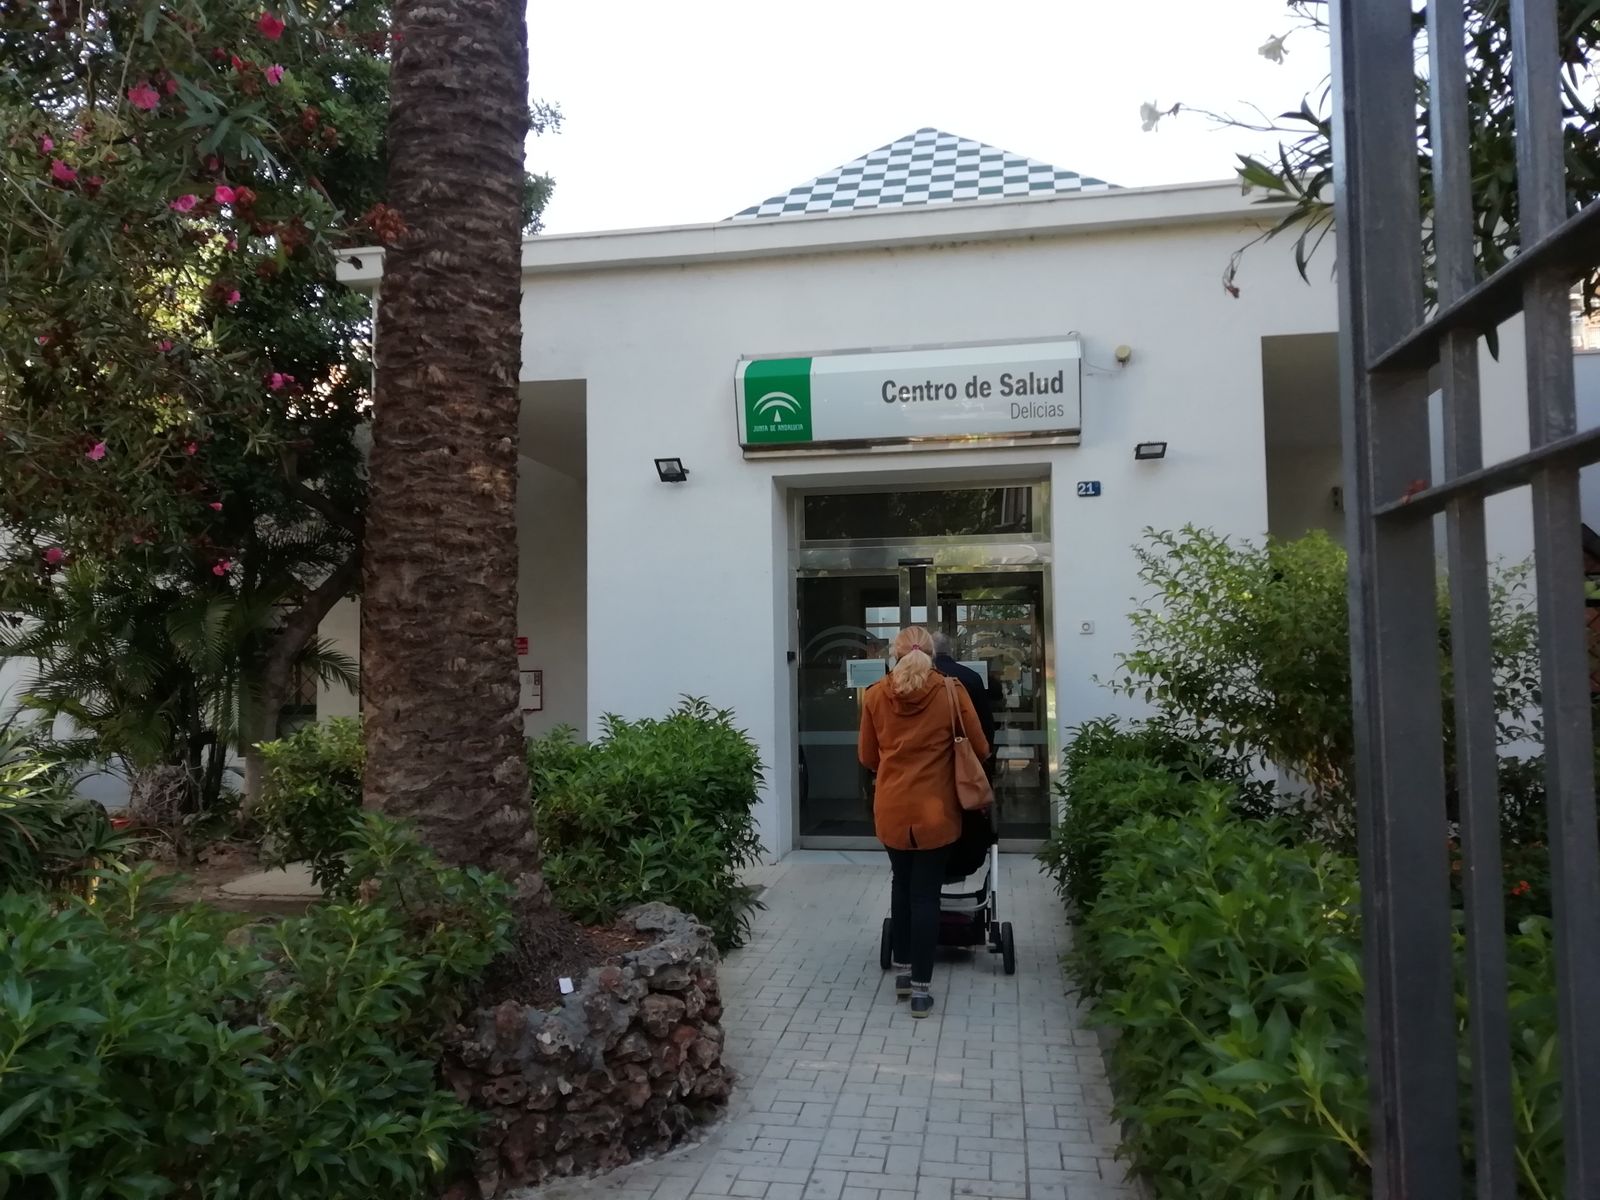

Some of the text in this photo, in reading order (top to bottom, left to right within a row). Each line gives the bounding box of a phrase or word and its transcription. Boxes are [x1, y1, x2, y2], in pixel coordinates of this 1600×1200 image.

[881, 370, 1064, 404] Centro de Salud
[1010, 401, 1065, 420] Delicias
[753, 425, 769, 433] JUNTA
[770, 424, 776, 432] DE
[1078, 483, 1095, 495] 21
